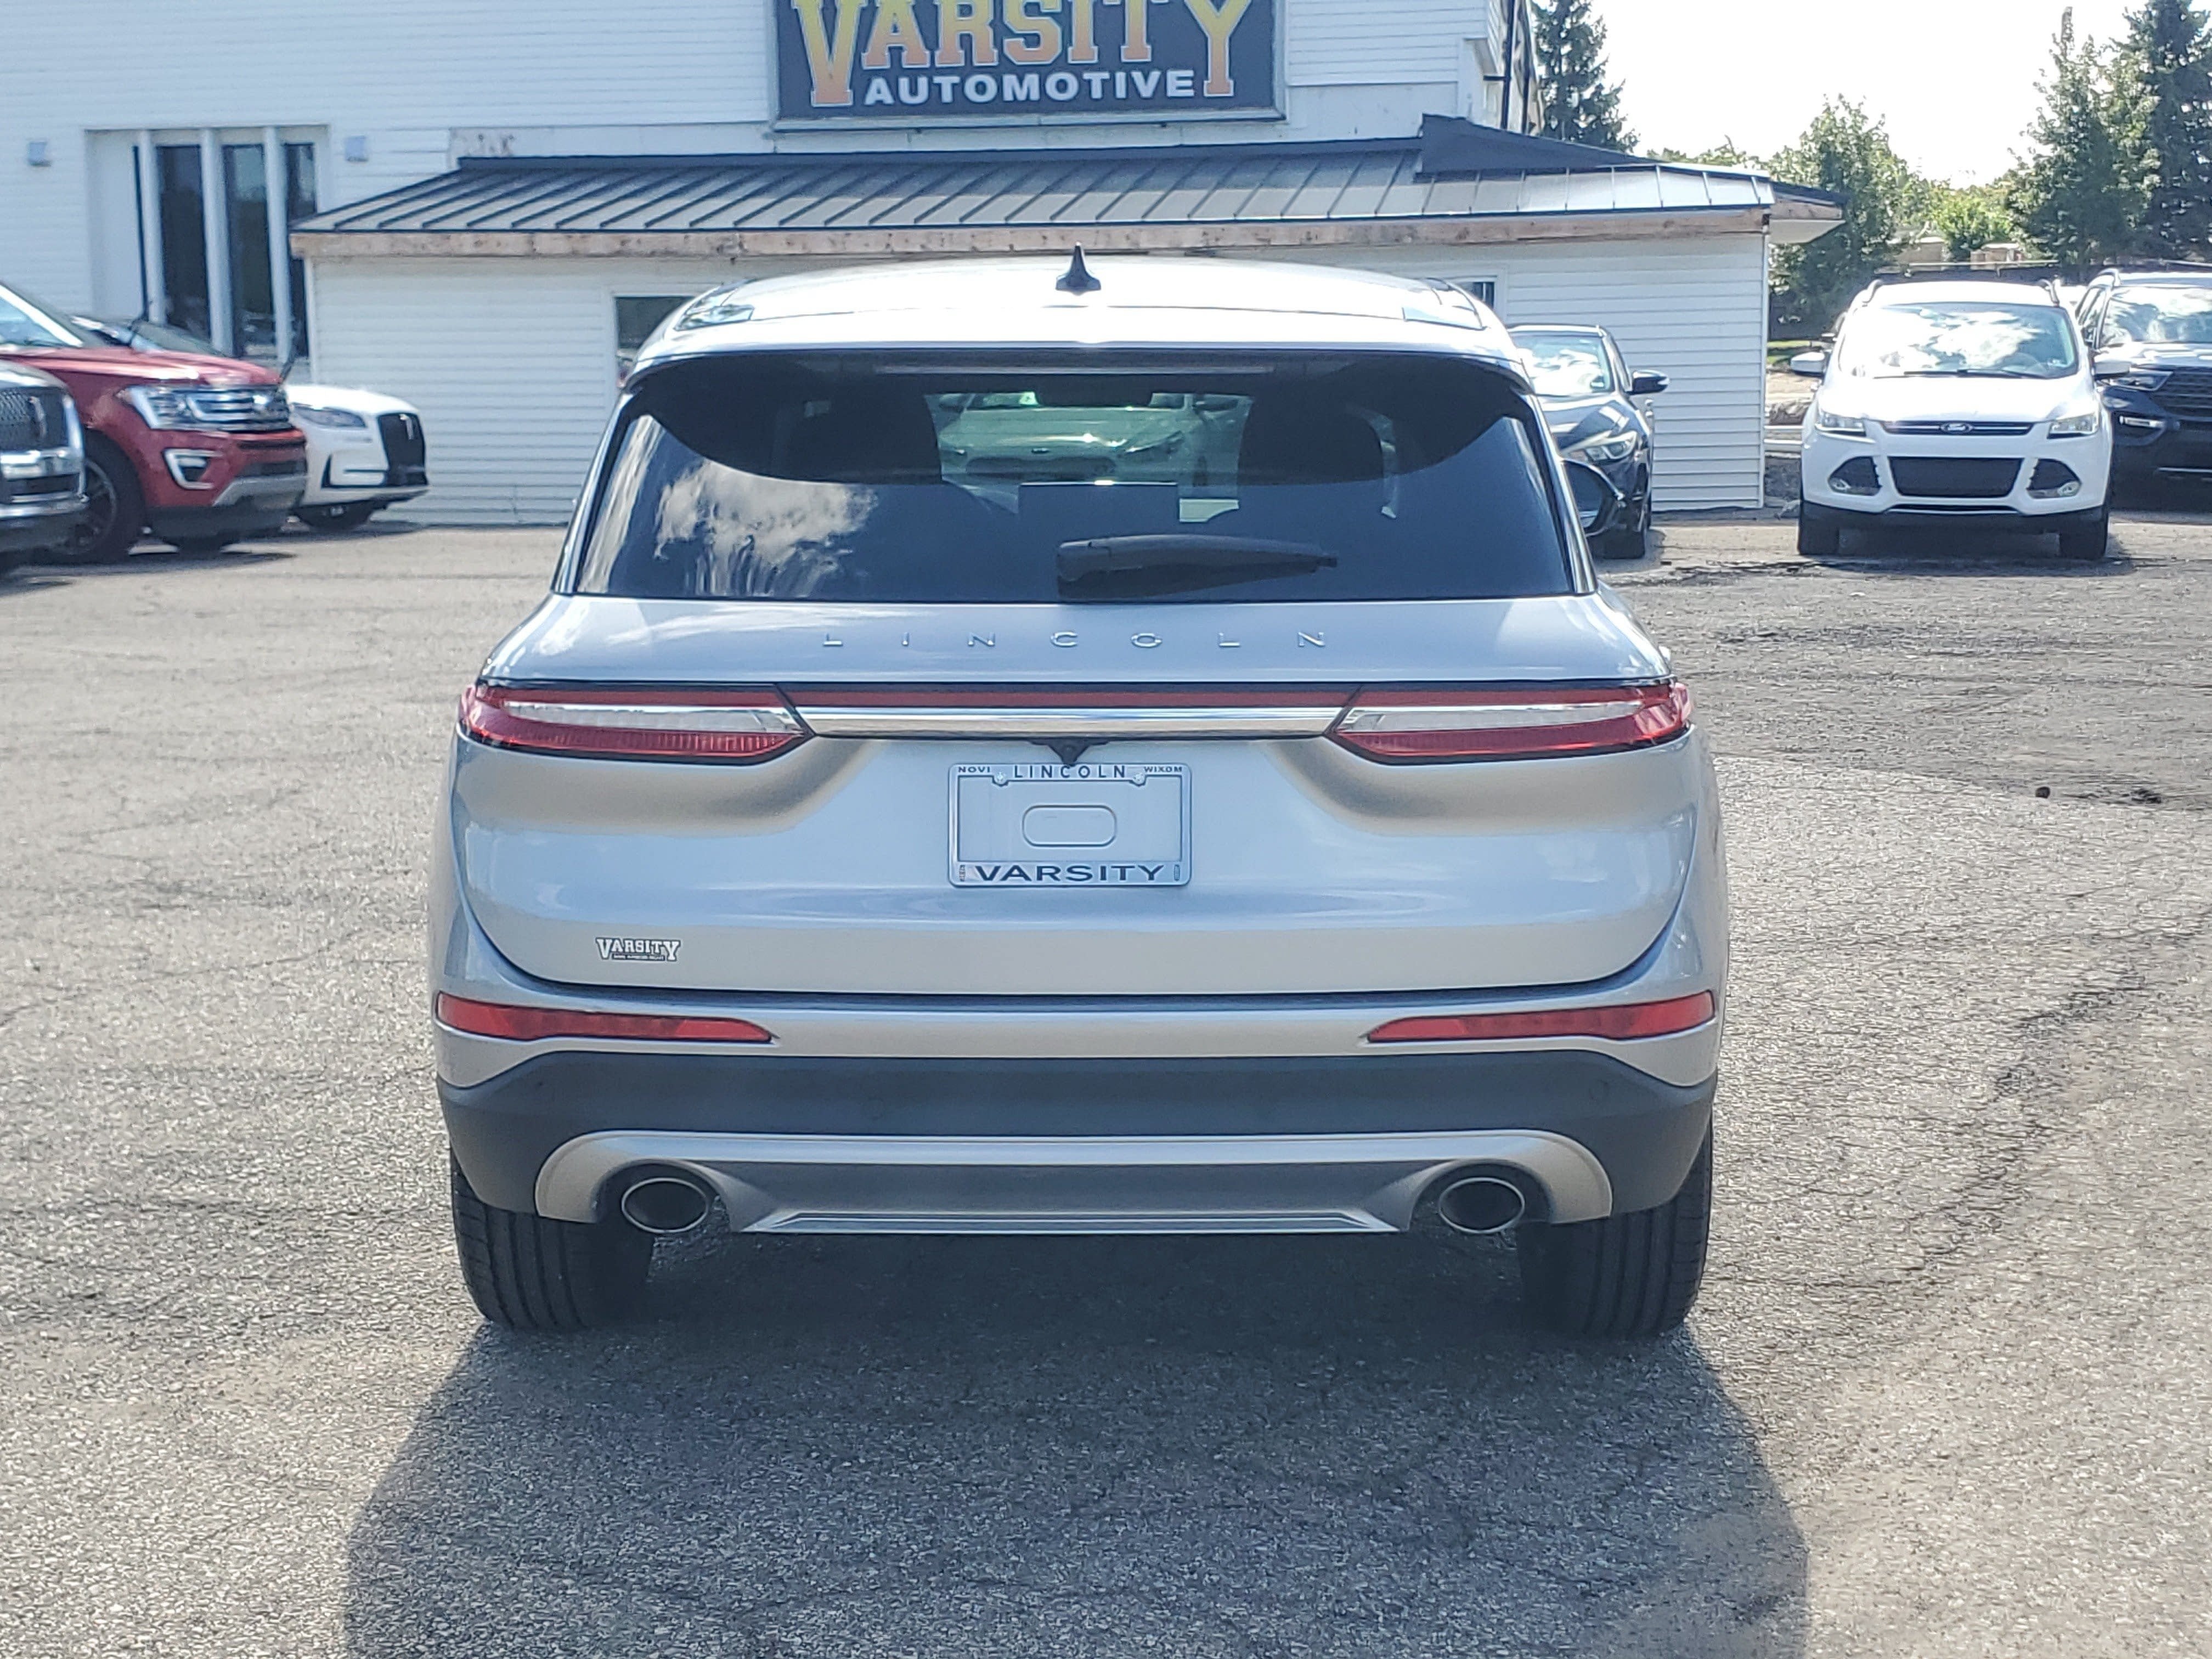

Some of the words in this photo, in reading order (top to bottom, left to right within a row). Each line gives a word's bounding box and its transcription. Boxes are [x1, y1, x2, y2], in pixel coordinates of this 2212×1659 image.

[793, 0, 1252, 106] VARSITY
[864, 70, 1194, 106] AUTOMOTIVE
[822, 631, 1326, 648] LINCOLN
[1014, 765, 1125, 778] LINCOLN
[975, 865, 1164, 882] VARSITY
[596, 938, 680, 961] VARSITY
